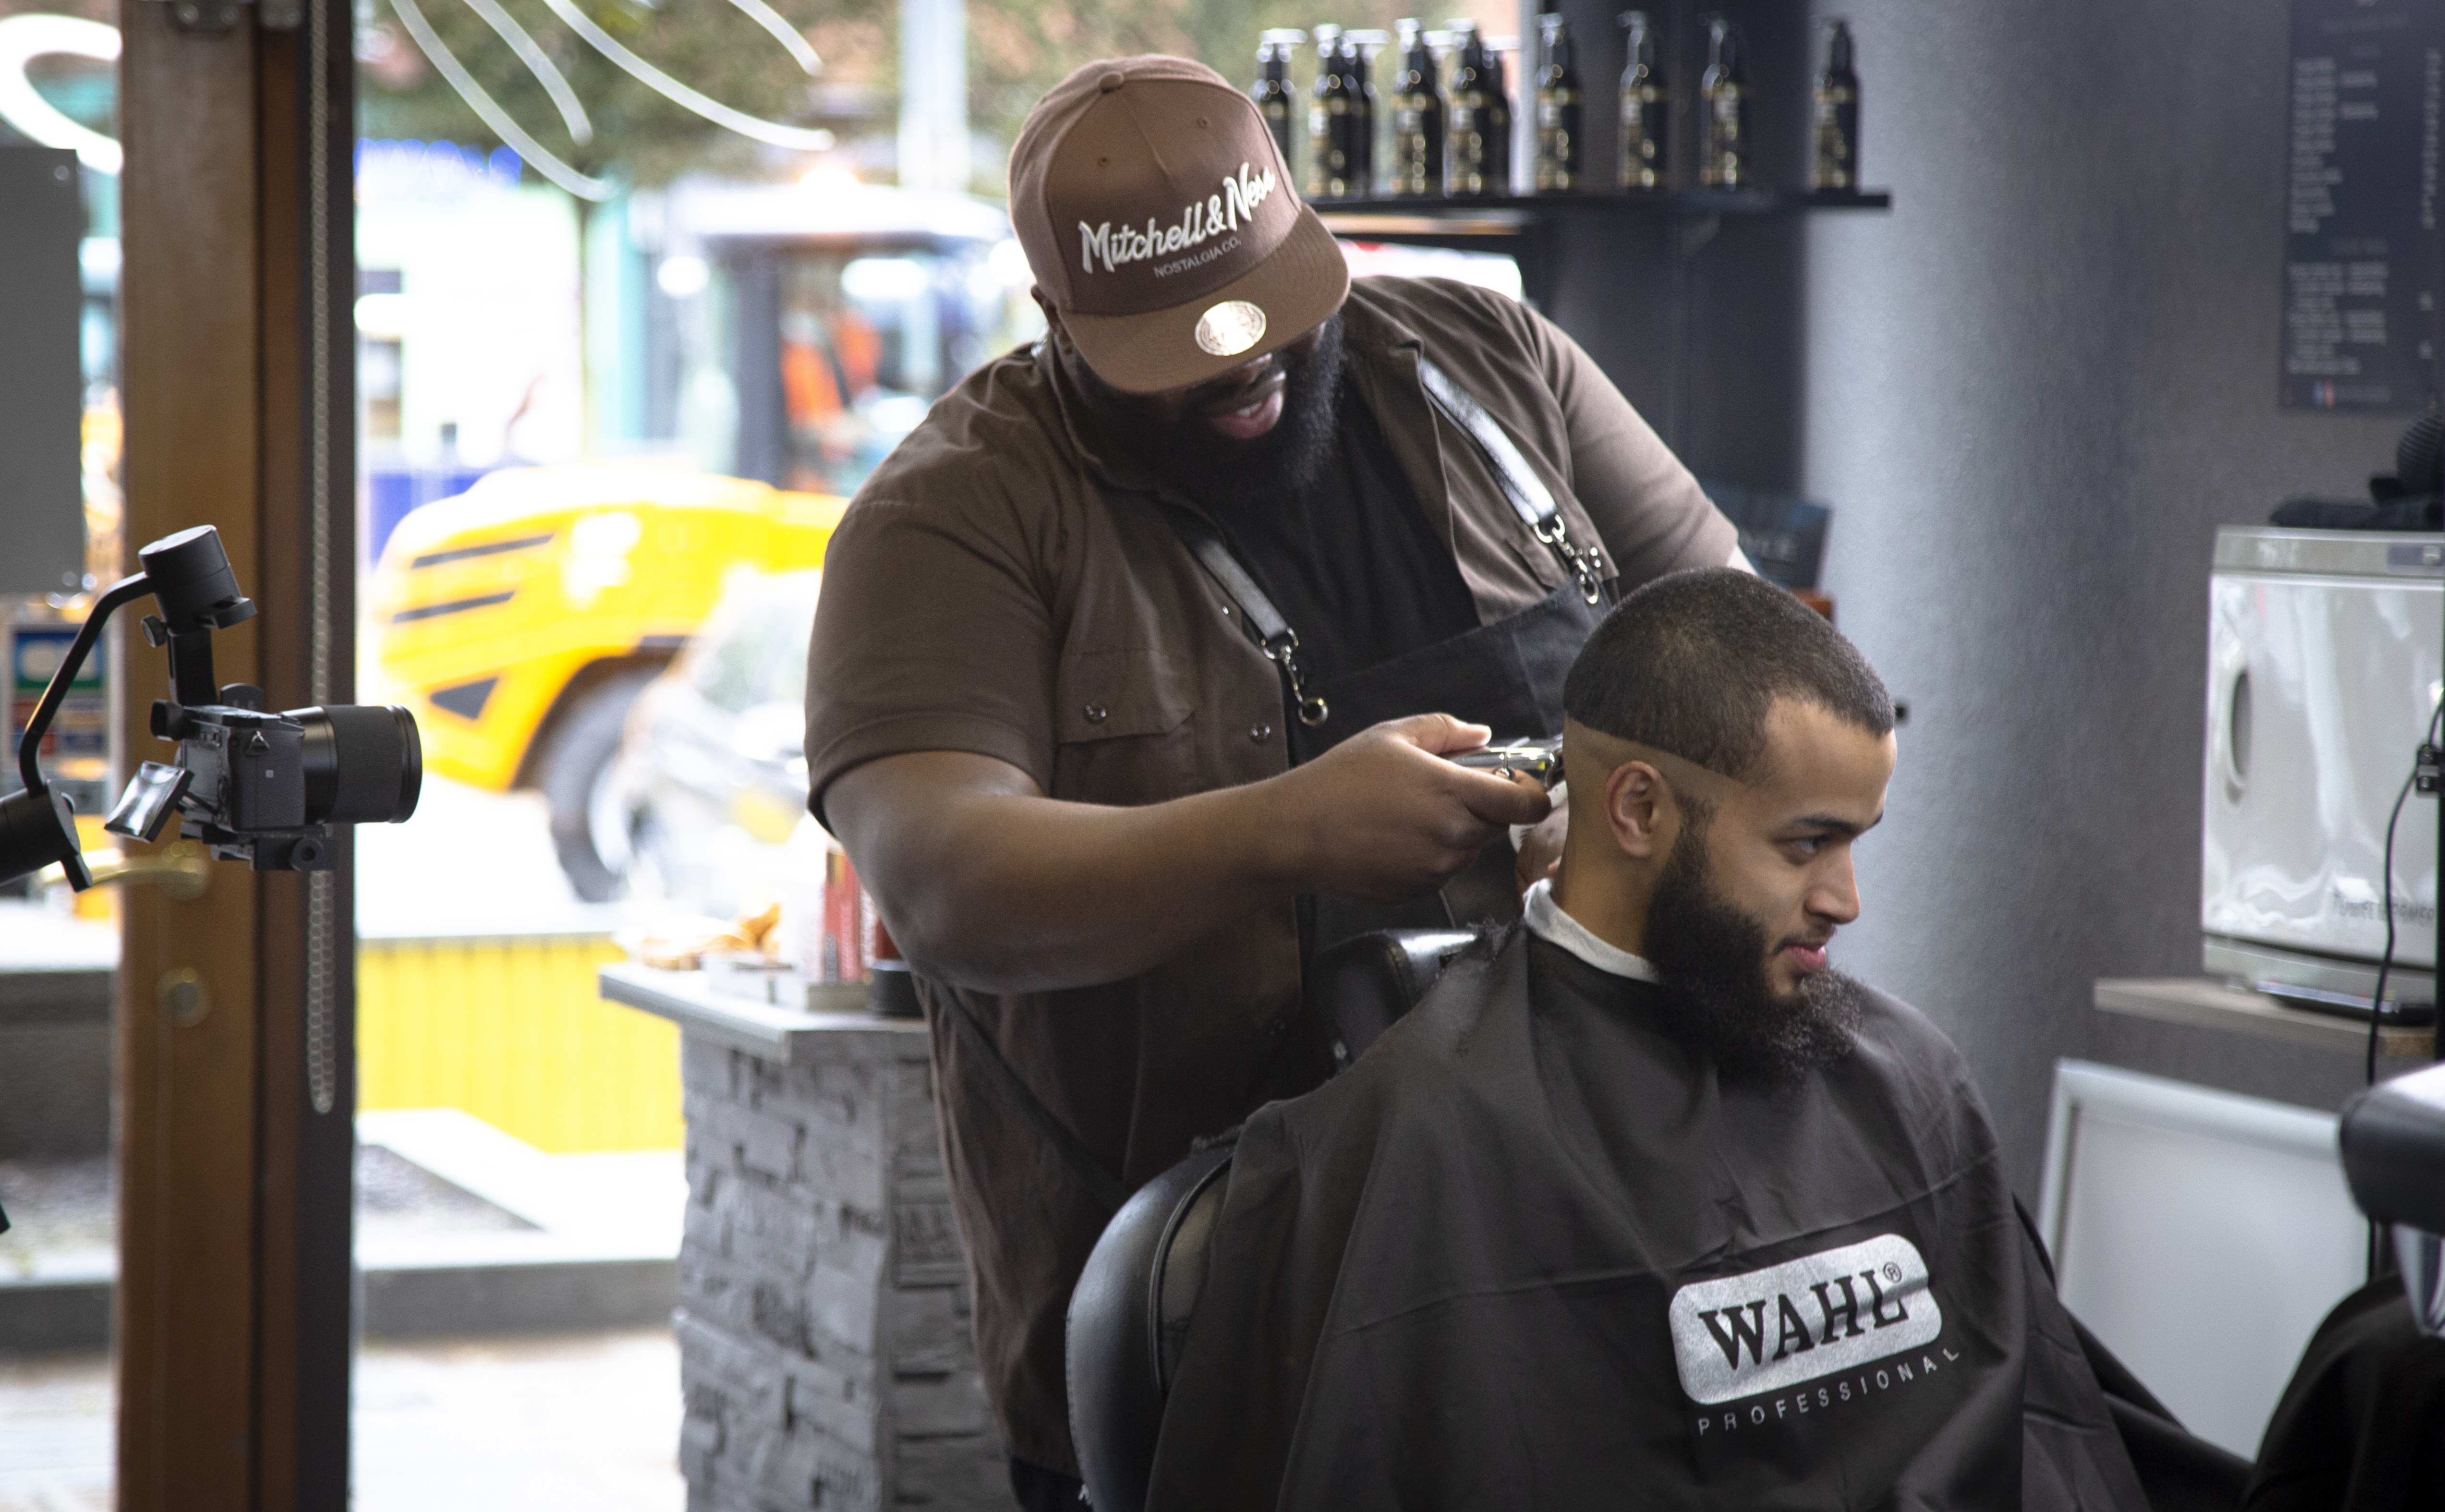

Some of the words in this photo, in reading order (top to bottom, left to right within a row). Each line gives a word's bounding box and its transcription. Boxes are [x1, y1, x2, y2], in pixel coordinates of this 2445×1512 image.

[1078, 201, 1207, 274] Mitchell
[1206, 194, 1227, 236] &
[1222, 162, 1276, 231] Ness
[1153, 246, 1223, 278] NOSTALGIA
[1698, 1348, 1959, 1436] PROFESSIONAL
